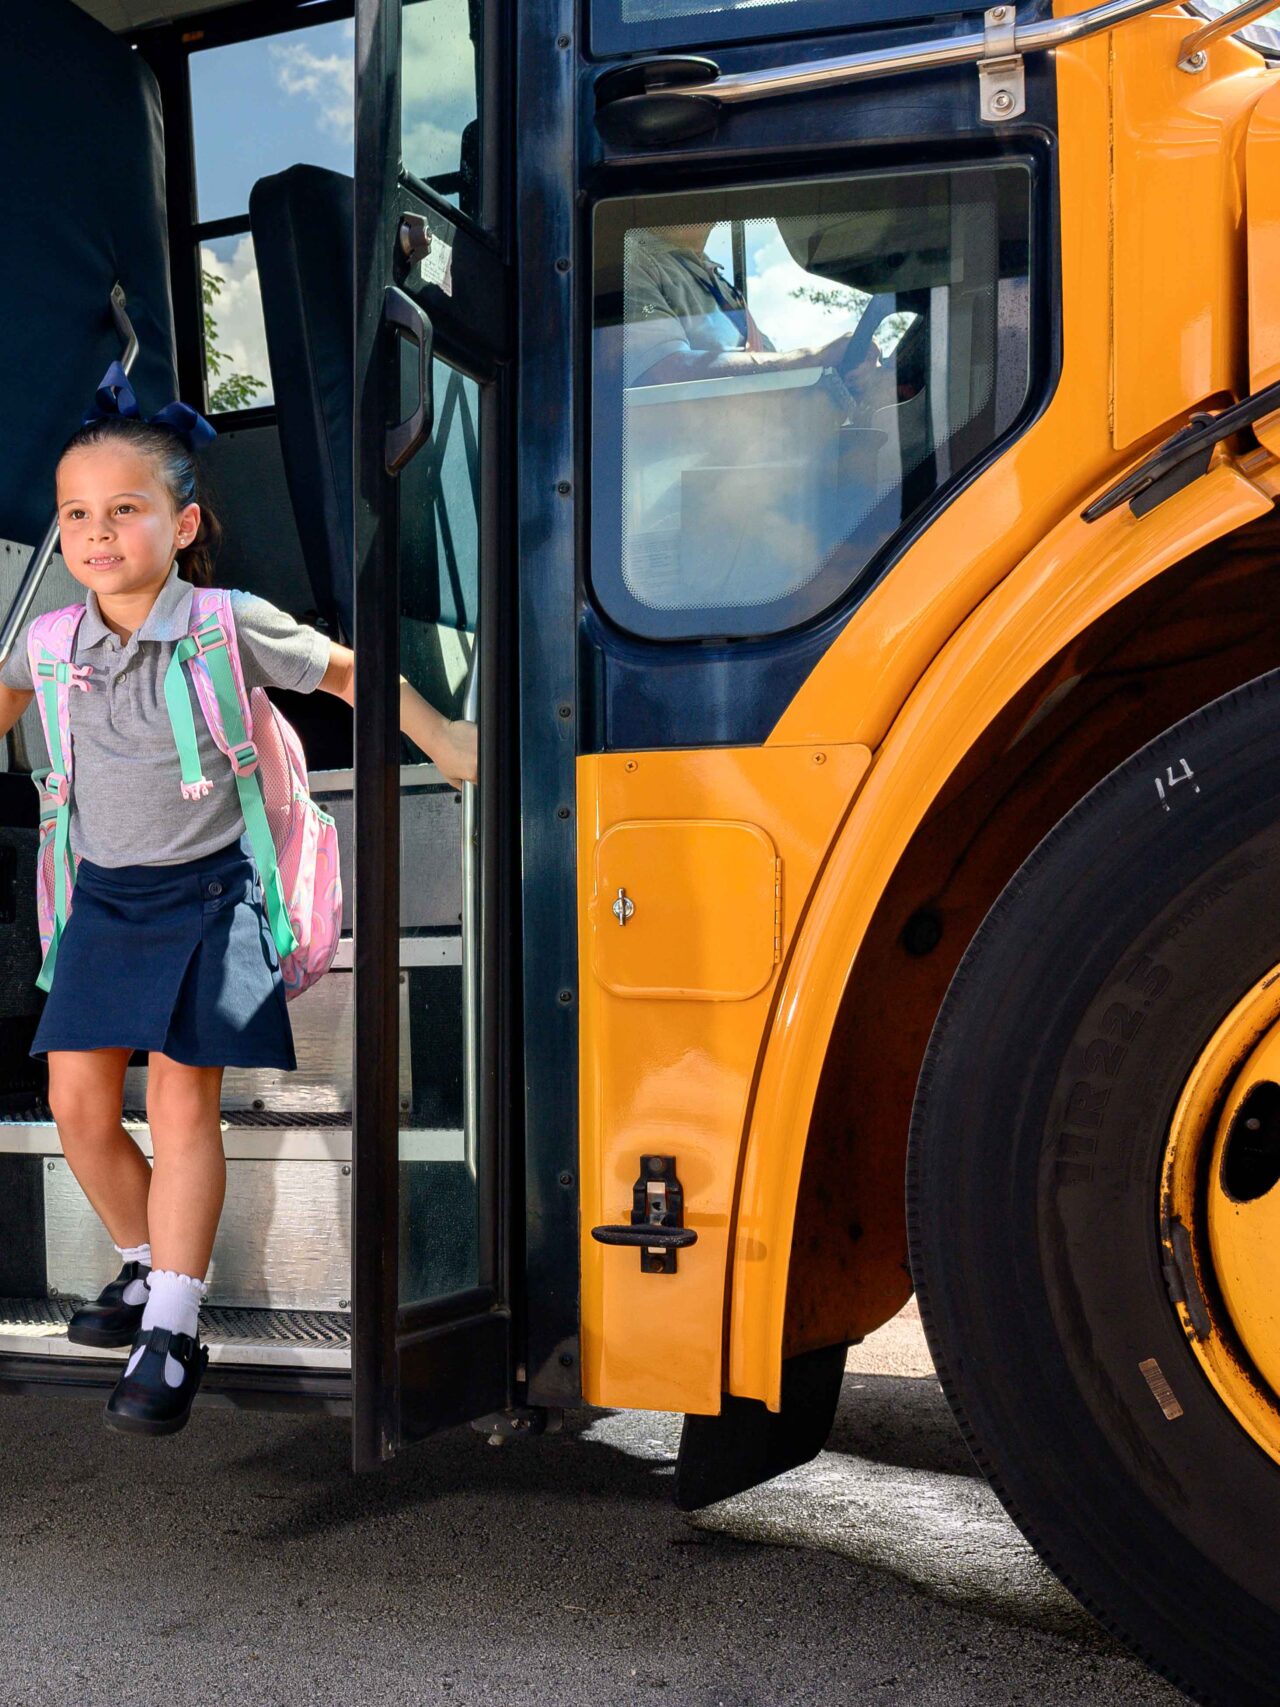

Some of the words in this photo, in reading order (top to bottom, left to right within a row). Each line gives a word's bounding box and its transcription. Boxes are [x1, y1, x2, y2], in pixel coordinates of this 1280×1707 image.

[1155, 758, 1200, 811] 14
[1165, 879, 1232, 942] RADIAL
[1056, 955, 1172, 1183] 11R22.5
